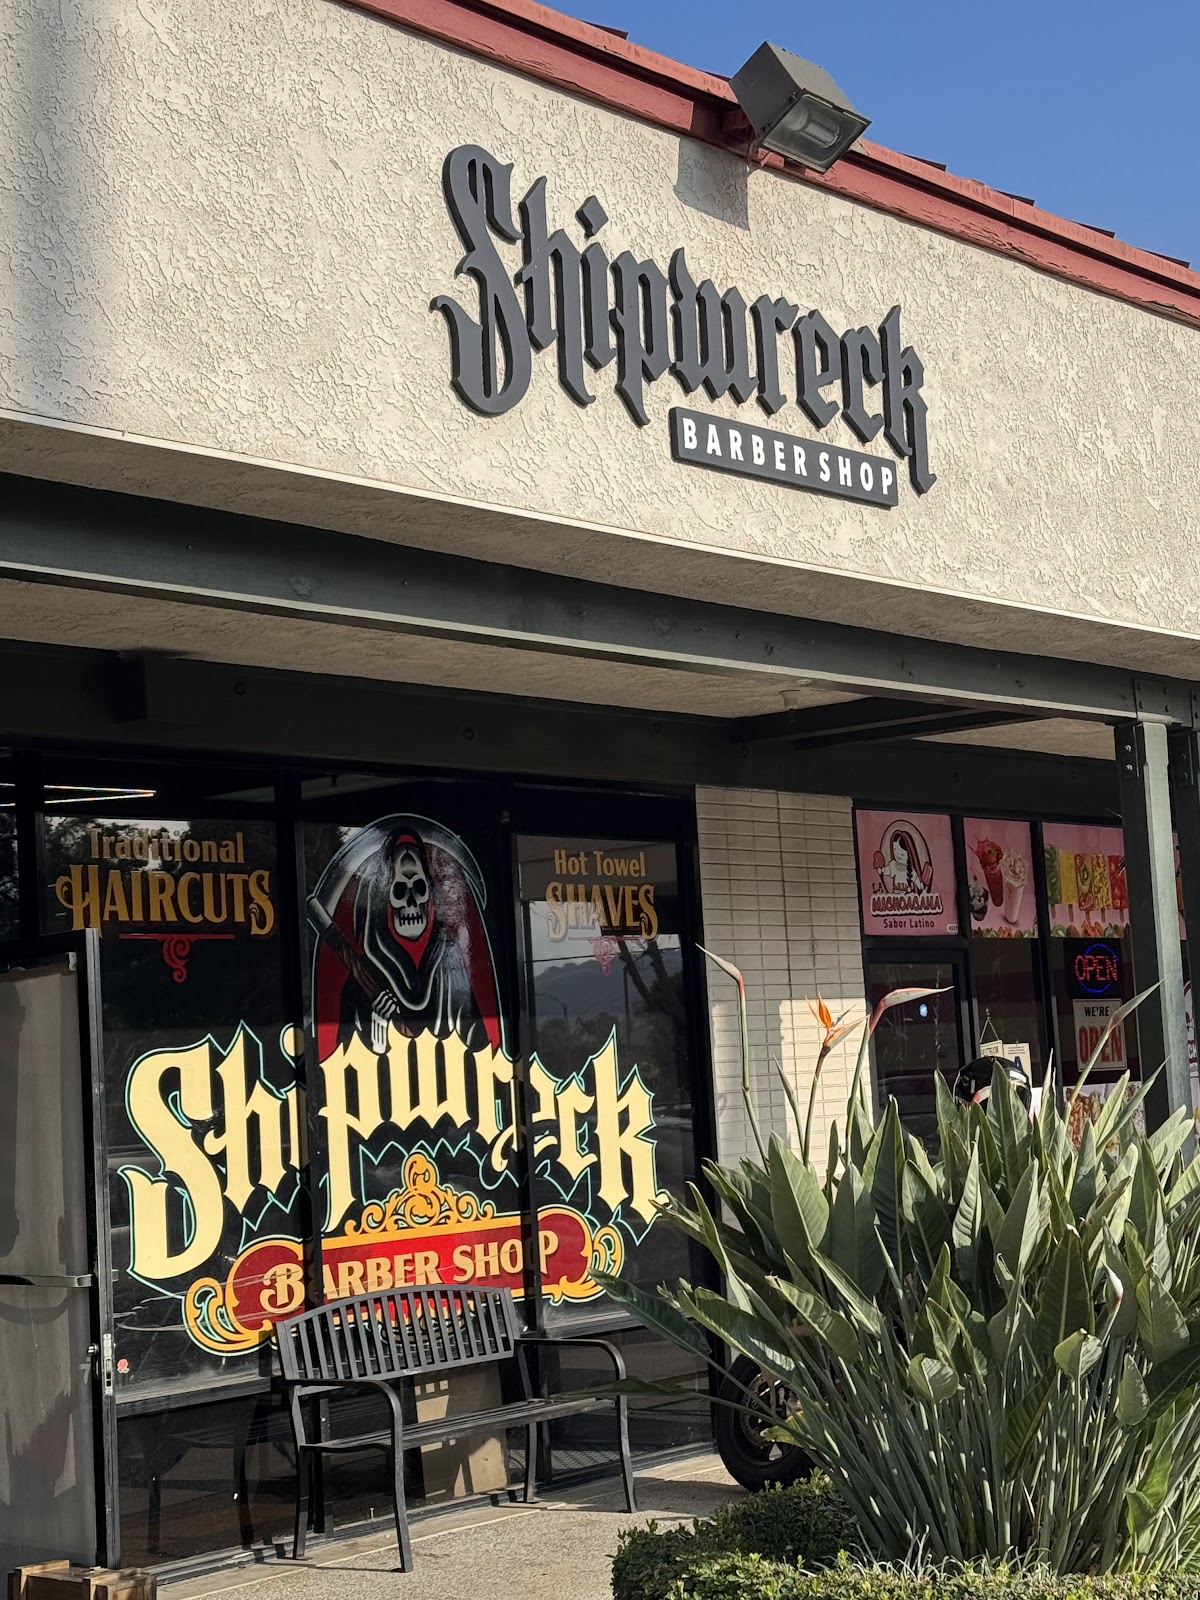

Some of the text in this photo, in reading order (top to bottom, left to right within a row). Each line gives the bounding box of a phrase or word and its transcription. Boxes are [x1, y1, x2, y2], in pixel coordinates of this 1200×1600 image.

[430, 143, 937, 496] Shipwreck
[90, 827, 245, 864] Traditional
[554, 849, 647, 878] Hot Towel
[55, 864, 275, 938] HAIRCUTS
[546, 881, 659, 942] SHAVES
[883, 918, 907, 929] Sabor
[909, 918, 935, 929] Latino
[1074, 955, 1118, 981] OPEN
[1084, 1005, 1110, 1017] WE'RE
[452, 1229, 559, 1283] SHOP
